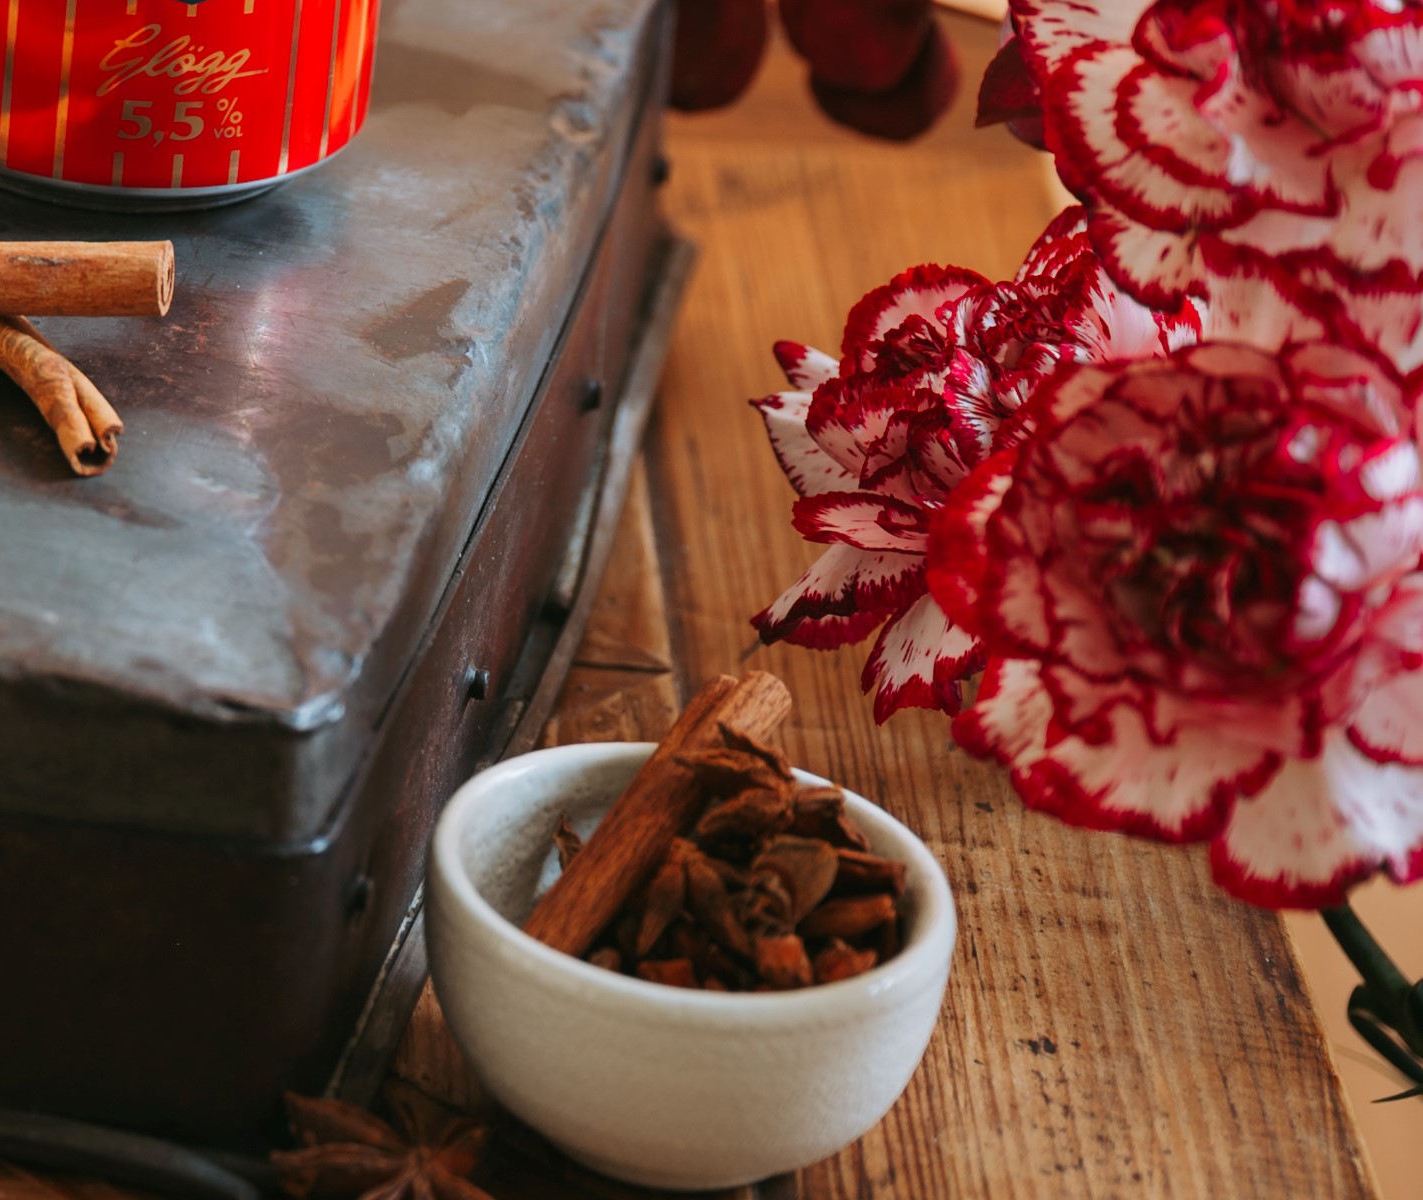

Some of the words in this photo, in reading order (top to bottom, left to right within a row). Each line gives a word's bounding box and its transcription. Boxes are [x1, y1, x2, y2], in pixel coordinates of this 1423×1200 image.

[96, 23, 269, 97] Glögg
[116, 99, 205, 148] 5,5
[213, 125, 243, 139] VOL
